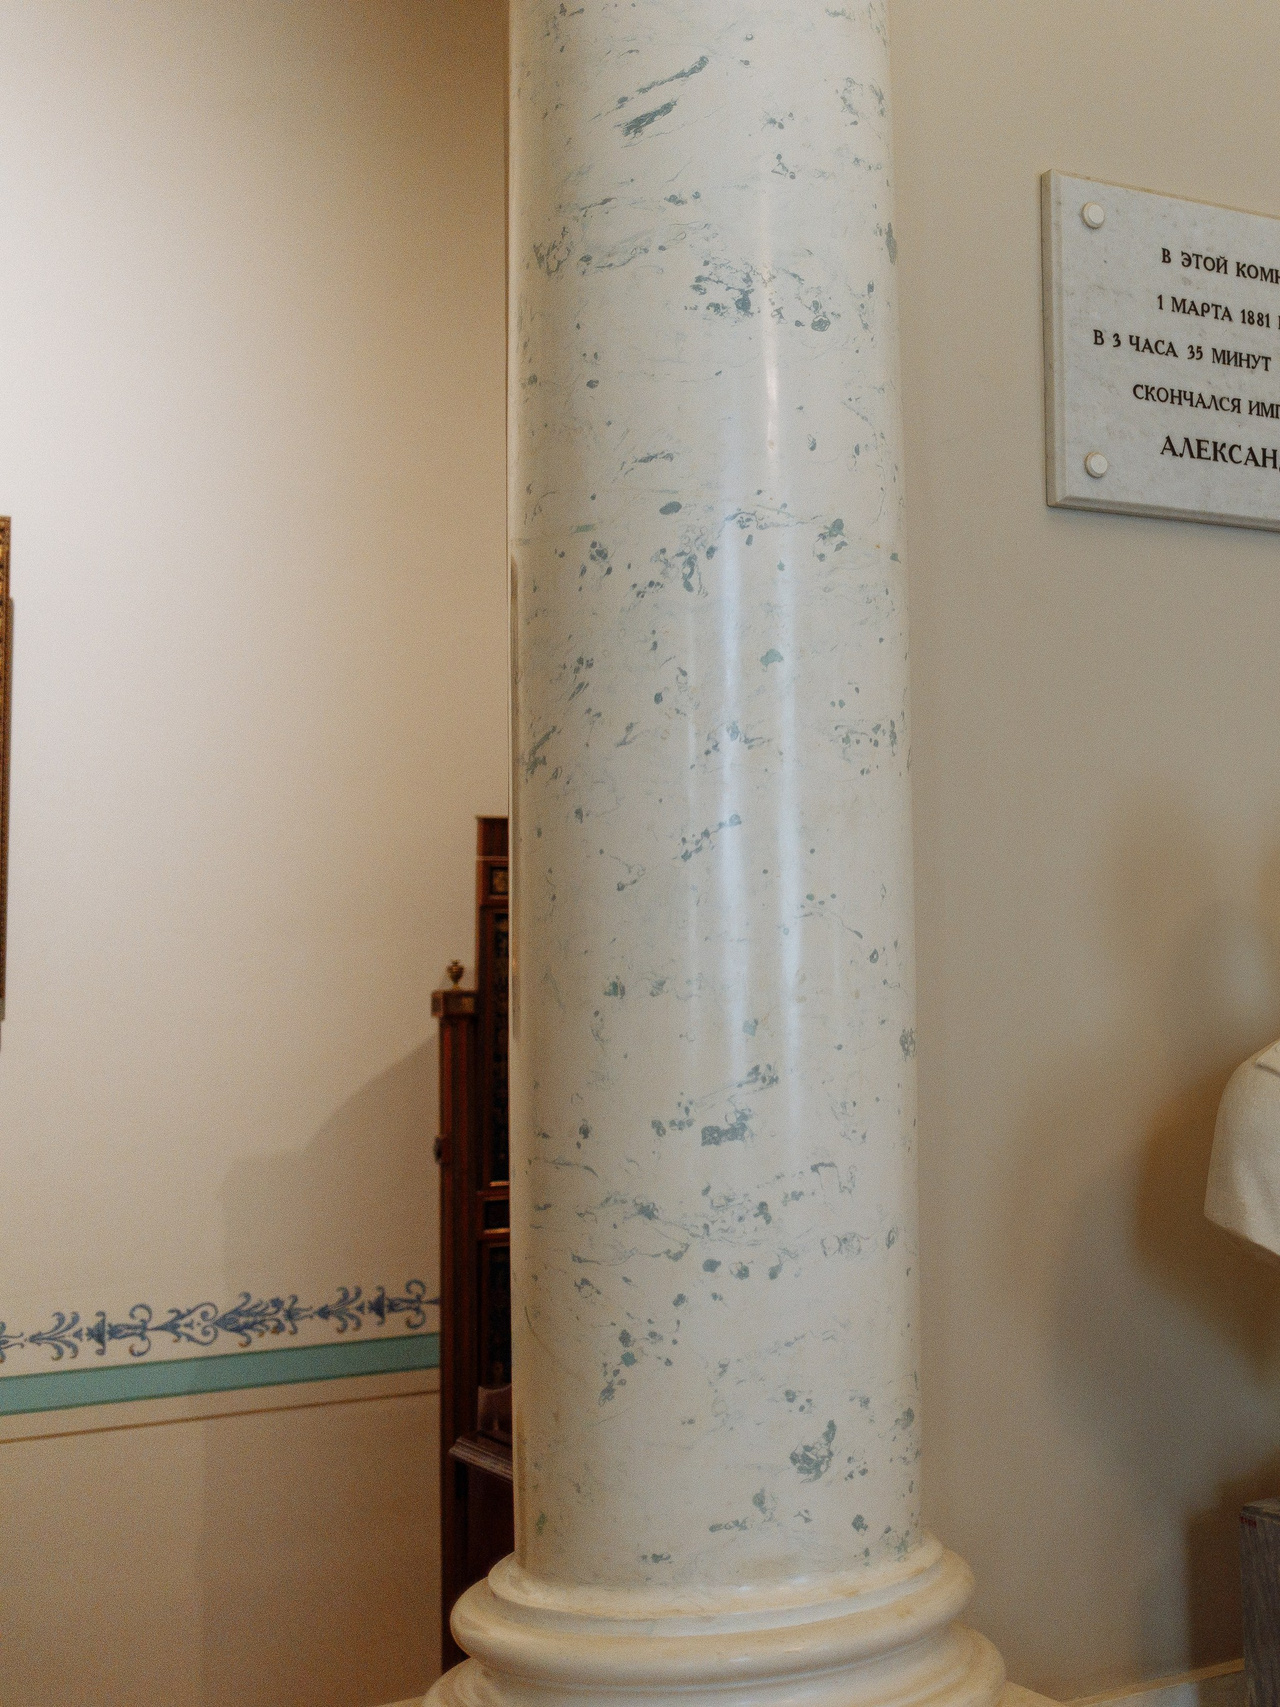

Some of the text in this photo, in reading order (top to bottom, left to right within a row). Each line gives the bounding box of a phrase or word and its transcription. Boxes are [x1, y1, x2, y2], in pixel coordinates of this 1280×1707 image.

[1161, 247, 1172, 264] В
[1180, 250, 1229, 275] ЭТОЙ
[1157, 294, 1164, 311] 1
[1170, 296, 1233, 323] МАРТА
[1240, 308, 1271, 329] 1881
[1092, 328, 1105, 346] В
[1112, 332, 1122, 348] 3
[1128, 334, 1179, 359] ЧАСА
[1187, 344, 1204, 361] 35
[1211, 347, 1272, 372] МИНУТ
[1132, 383, 1242, 414] СКОНЧАЛСЯ
